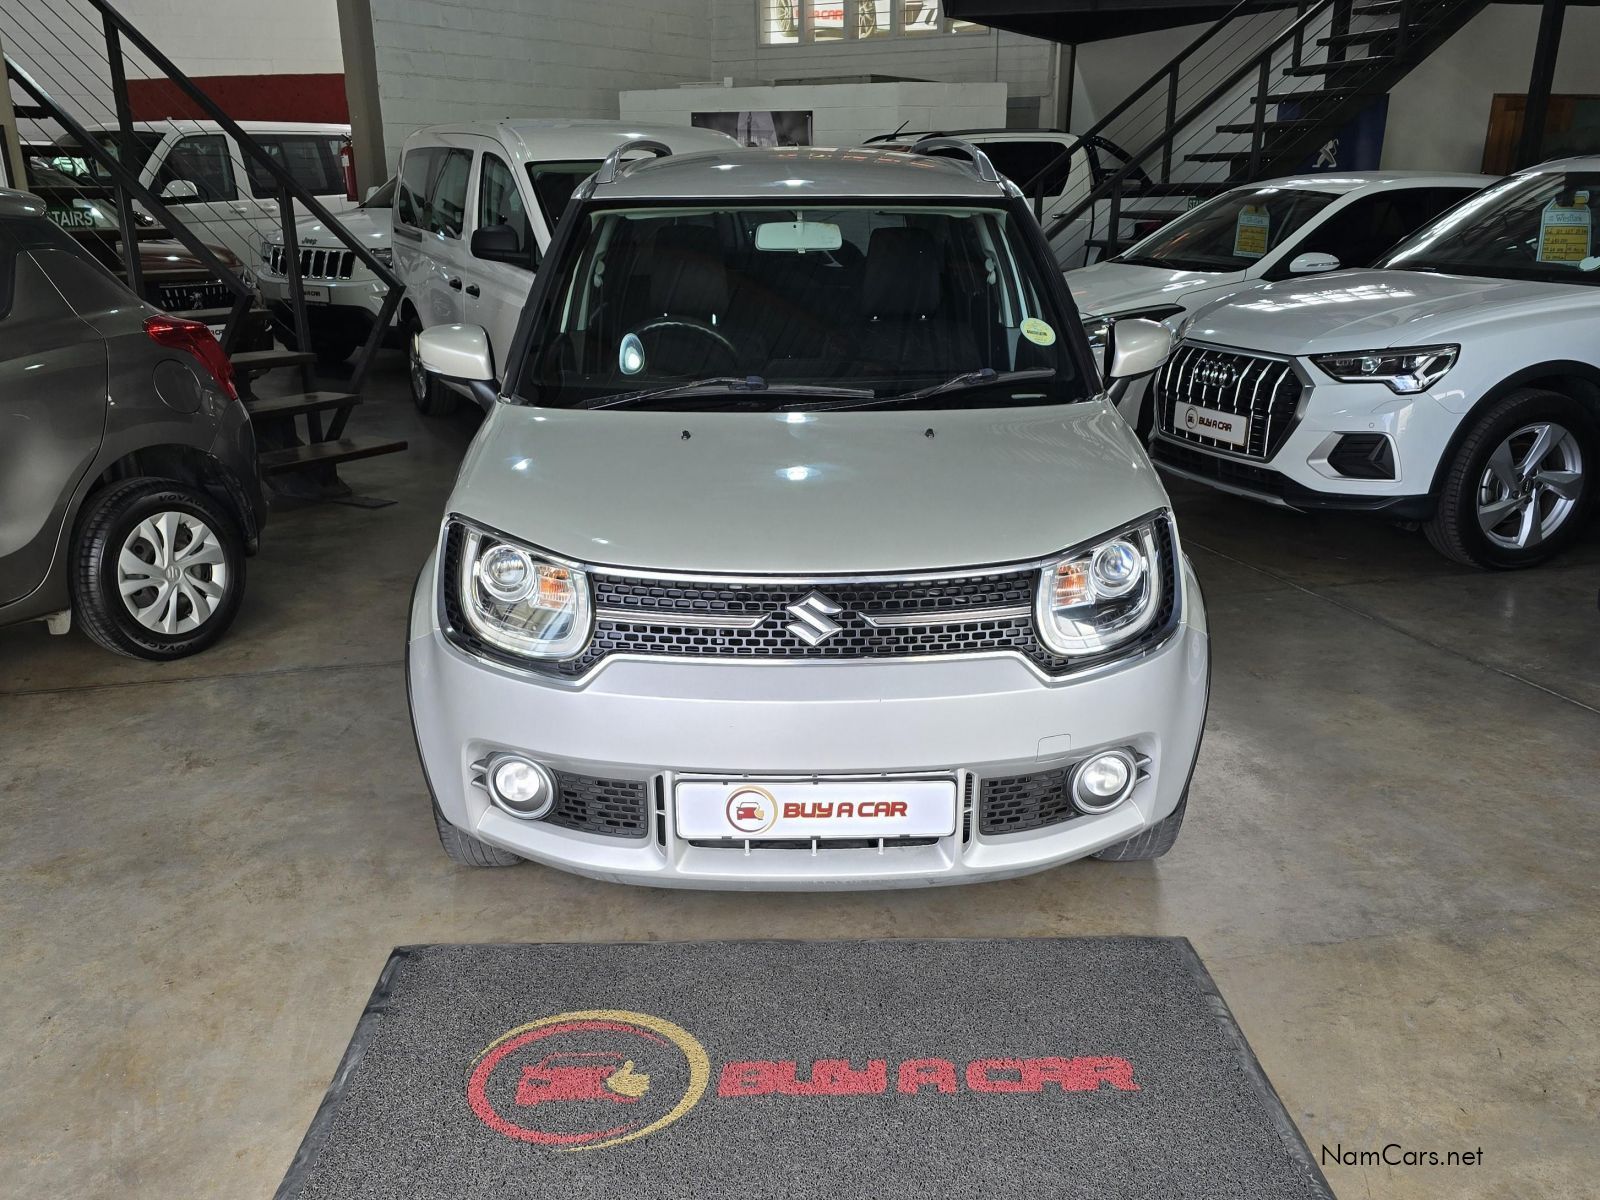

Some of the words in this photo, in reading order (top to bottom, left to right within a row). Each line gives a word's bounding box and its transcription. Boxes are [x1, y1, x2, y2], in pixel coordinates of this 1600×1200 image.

[50, 210, 93, 226] TAIRS
[1198, 416, 1212, 427] BUY
[1212, 420, 1217, 429] A
[1218, 421, 1232, 432] CAR
[783, 802, 834, 818] BUY
[836, 802, 853, 818] A
[857, 801, 908, 817] CAR
[718, 1058, 886, 1097] BUY
[896, 1058, 957, 1094] A
[966, 1055, 1141, 1092] CAR
